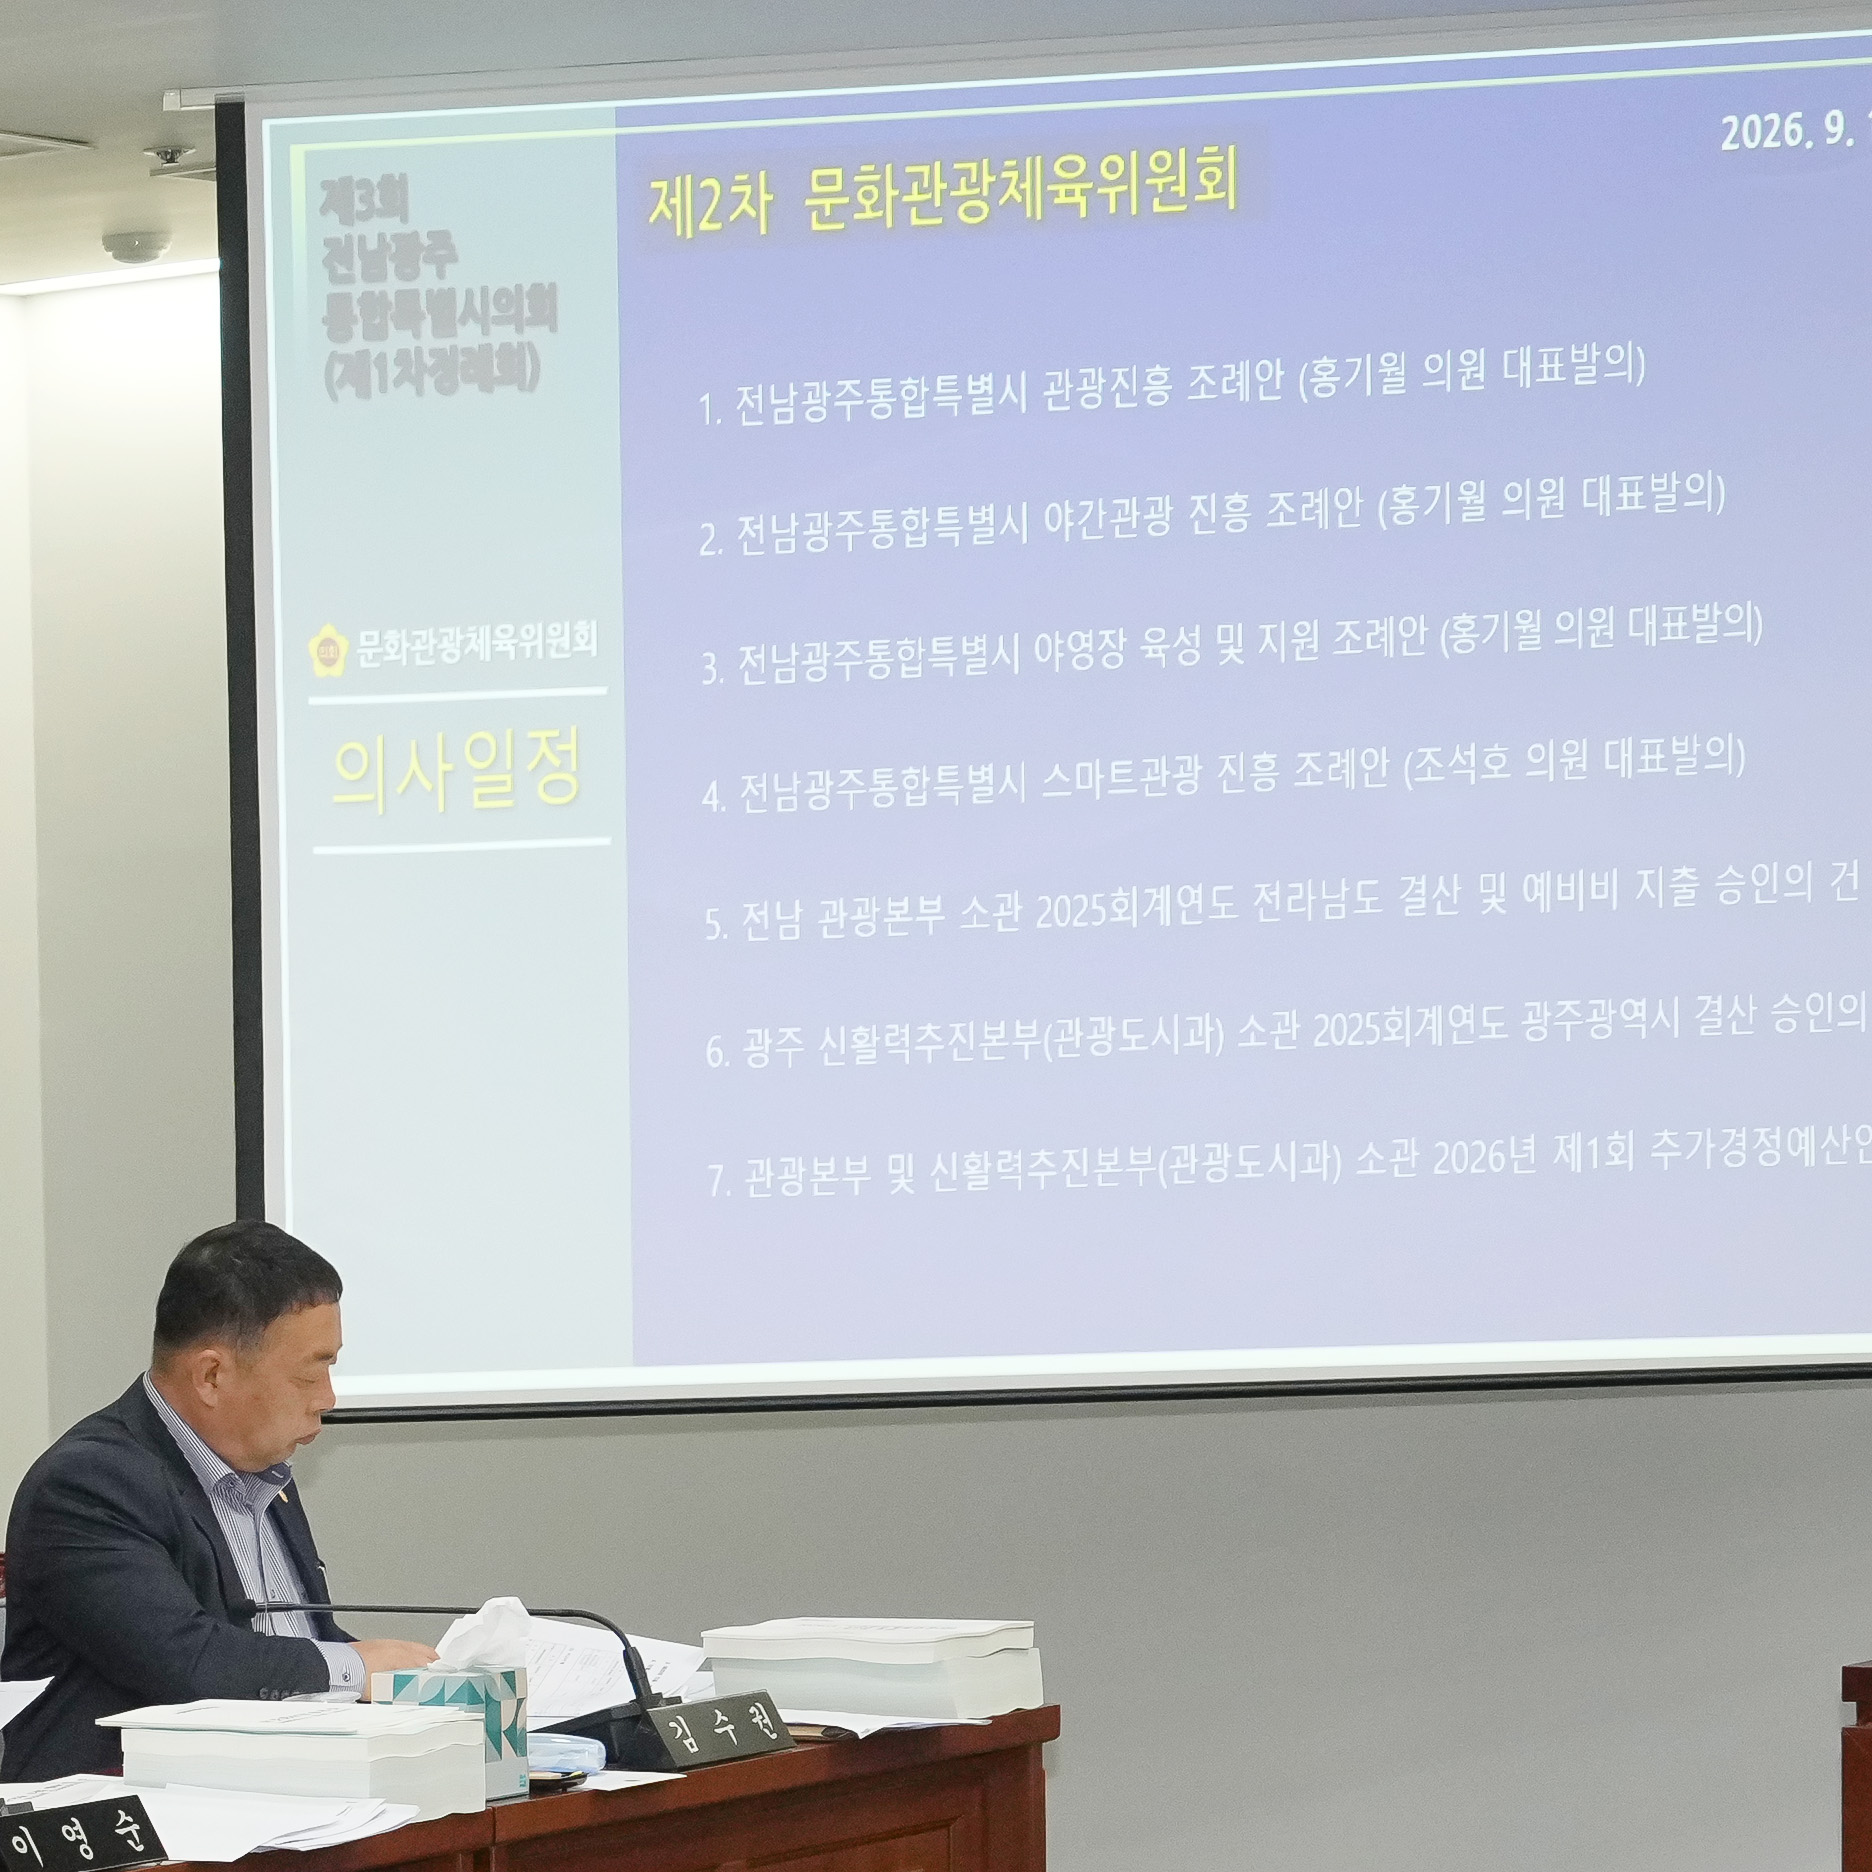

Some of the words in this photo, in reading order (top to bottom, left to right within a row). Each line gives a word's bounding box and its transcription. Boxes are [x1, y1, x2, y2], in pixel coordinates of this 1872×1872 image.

[1721, 111, 1813, 151] 2026.
[1824, 109, 1854, 147] 9.
[319, 172, 409, 227] 제3회
[649, 171, 774, 238] 제2차
[806, 145, 1237, 232] 문화관광체육위원회
[322, 229, 459, 285] 전남광주
[322, 282, 558, 344] 통합특별시의회
[699, 392, 722, 425] 1.
[736, 370, 1026, 427] 전남광주통합특별시
[1043, 364, 1173, 412] 관광진흥
[1187, 358, 1285, 402] 조례안
[1299, 351, 1406, 404] (홍기월
[1422, 347, 1485, 393] 의원
[1503, 340, 1645, 389] 대표발의)
[699, 522, 723, 557] 2.
[737, 501, 1028, 556] 전남광주통합특별시
[1044, 494, 1174, 542] 야간관광
[1189, 491, 1252, 535] 진흥
[1266, 485, 1364, 530] 조례안
[1378, 479, 1485, 531] (홍기월
[1502, 476, 1564, 521] 의원
[1582, 469, 1725, 517] 대표발의)
[357, 619, 598, 668] 문화관광체육위원회
[702, 651, 724, 685] 3.
[739, 632, 1019, 686] 전남광주통합특별시
[1034, 627, 1128, 673] 야영장
[1140, 624, 1201, 668] 육성
[1216, 622, 1245, 666] 및
[1258, 619, 1319, 663] 지원
[1333, 614, 1429, 658] 조례안
[1440, 609, 1542, 659] (홍기월
[1554, 605, 1614, 650] 의원
[1628, 600, 1763, 647] 대표발의)
[332, 724, 580, 816] 의사일정
[701, 780, 726, 813] 4.
[740, 761, 1025, 814] 전남광주통합특별시
[1042, 754, 1203, 800] 스마트관광
[1217, 751, 1280, 794] 진흥
[1294, 746, 1390, 790] 조례안
[1404, 742, 1511, 791] (조석호
[1525, 738, 1587, 782] 의원
[1604, 732, 1745, 779] 대표발의)
[705, 907, 728, 941] 5.
[743, 899, 803, 942] 전남
[818, 894, 946, 939] 관광본부
[960, 889, 1023, 932] 소관
[1036, 882, 1239, 929] 2025회계연도
[1253, 877, 1383, 923] 전라남도
[1399, 873, 1462, 917] 결산
[1479, 871, 1507, 915] 및
[1522, 867, 1618, 913] 예비비
[1636, 865, 1700, 909] 지출
[1715, 860, 1812, 905] 승인의
[1830, 859, 1858, 902] 건
[706, 1035, 730, 1068] 6.
[743, 1027, 805, 1069] 광주
[819, 1012, 1224, 1066] 신활력추진본부(관광도시과)
[1237, 1009, 1301, 1050] 소관
[1313, 1003, 1509, 1048] 2025회계연도
[1521, 995, 1679, 1042] 광주광역시
[1695, 994, 1758, 1036] 결산
[1770, 990, 1866, 1034] 승인의
[707, 1164, 731, 1197] 7.
[745, 1155, 872, 1198] 관광본부
[888, 1153, 915, 1195] 및
[930, 1139, 1342, 1192] 신활력추진본부(관광도시과)
[1356, 1136, 1420, 1178] 소관
[1433, 1133, 1536, 1175] 2026년
[1553, 1129, 1634, 1173] 제1회
[12, 1810, 144, 1868] 이영순
